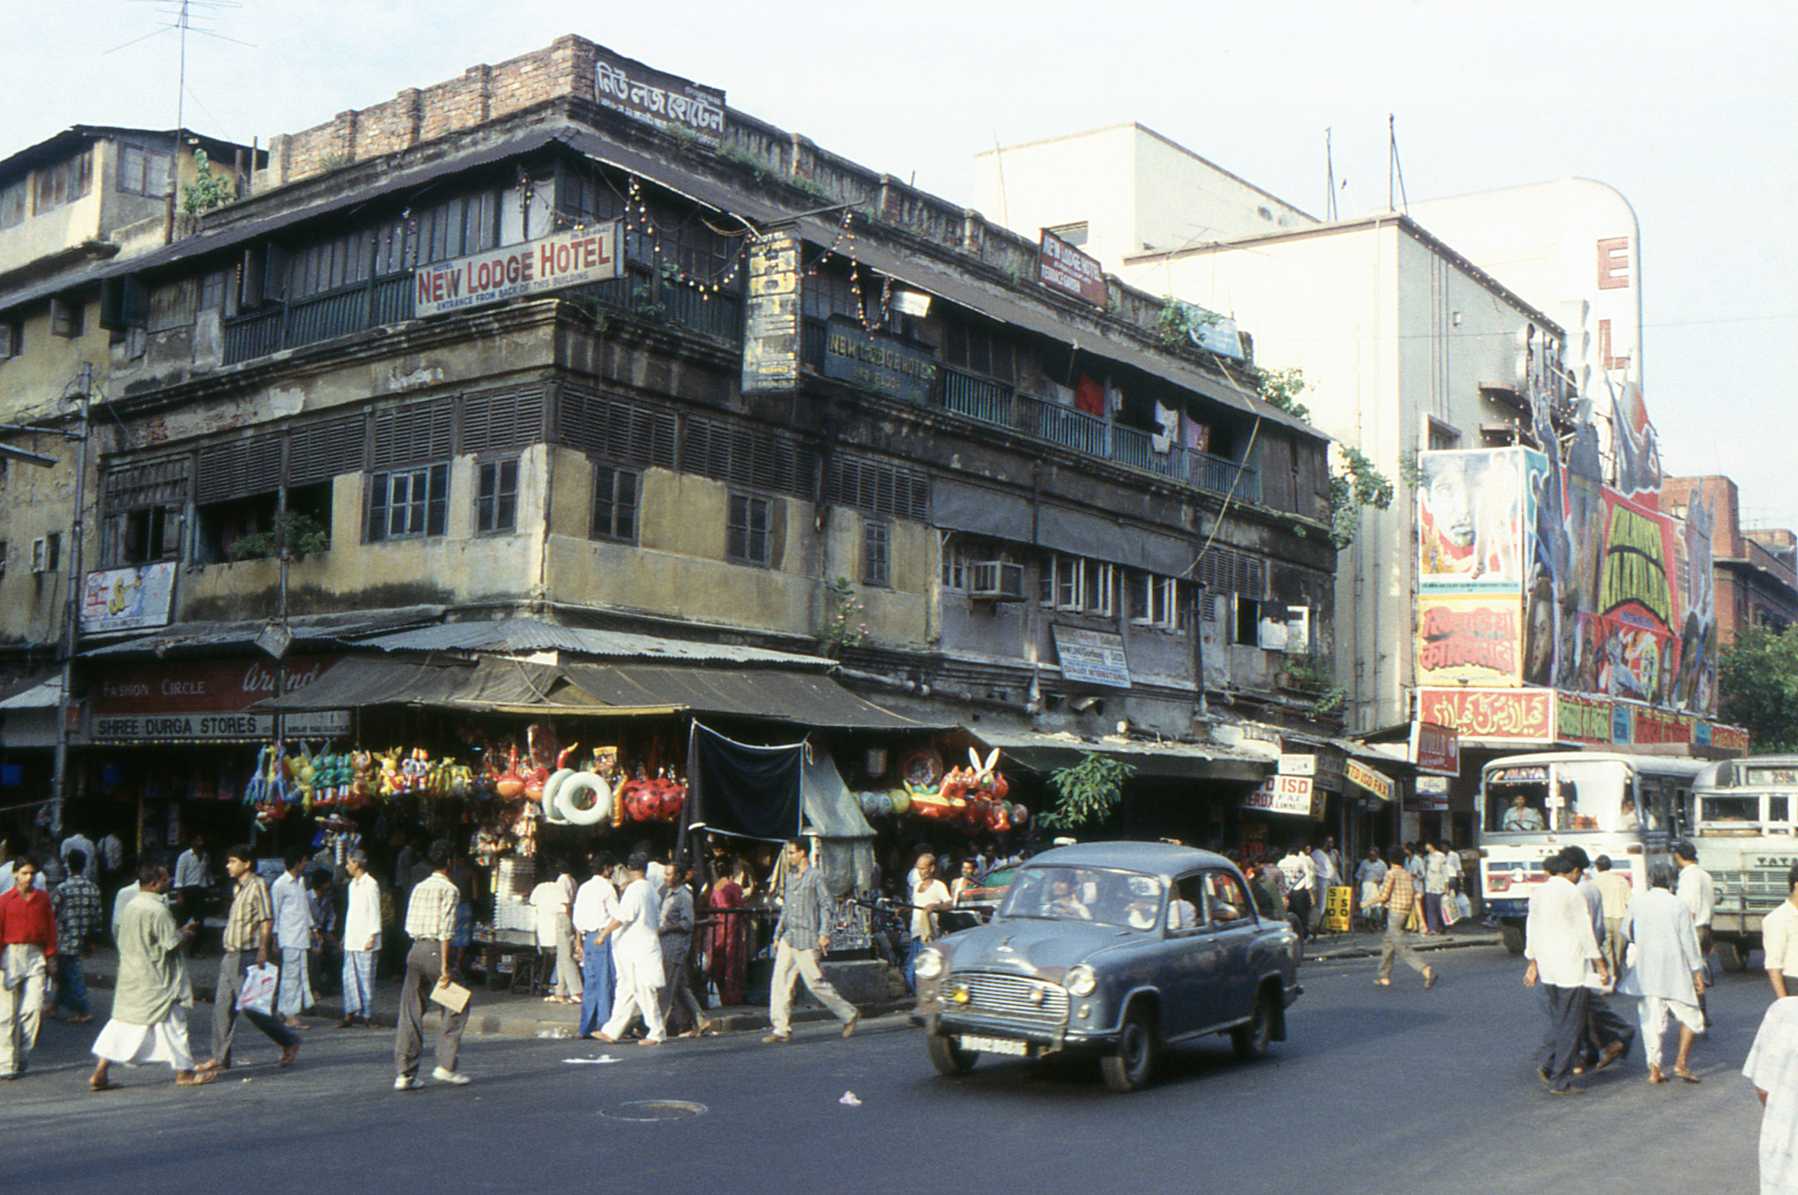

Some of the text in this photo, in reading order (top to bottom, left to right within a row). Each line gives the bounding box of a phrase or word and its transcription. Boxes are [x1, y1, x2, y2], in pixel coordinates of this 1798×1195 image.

[629, 80, 666, 114] লজ
[418, 237, 610, 304] NEW LODGE HOTEL
[437, 295, 472, 311] ENTRANCE
[476, 292, 496, 305] FROM
[161, 678, 207, 696] CIRCLE
[100, 717, 139, 735] SHREE
[145, 717, 193, 735] DURGA
[201, 716, 257, 734] STORES
[1281, 777, 1309, 794] ISD
